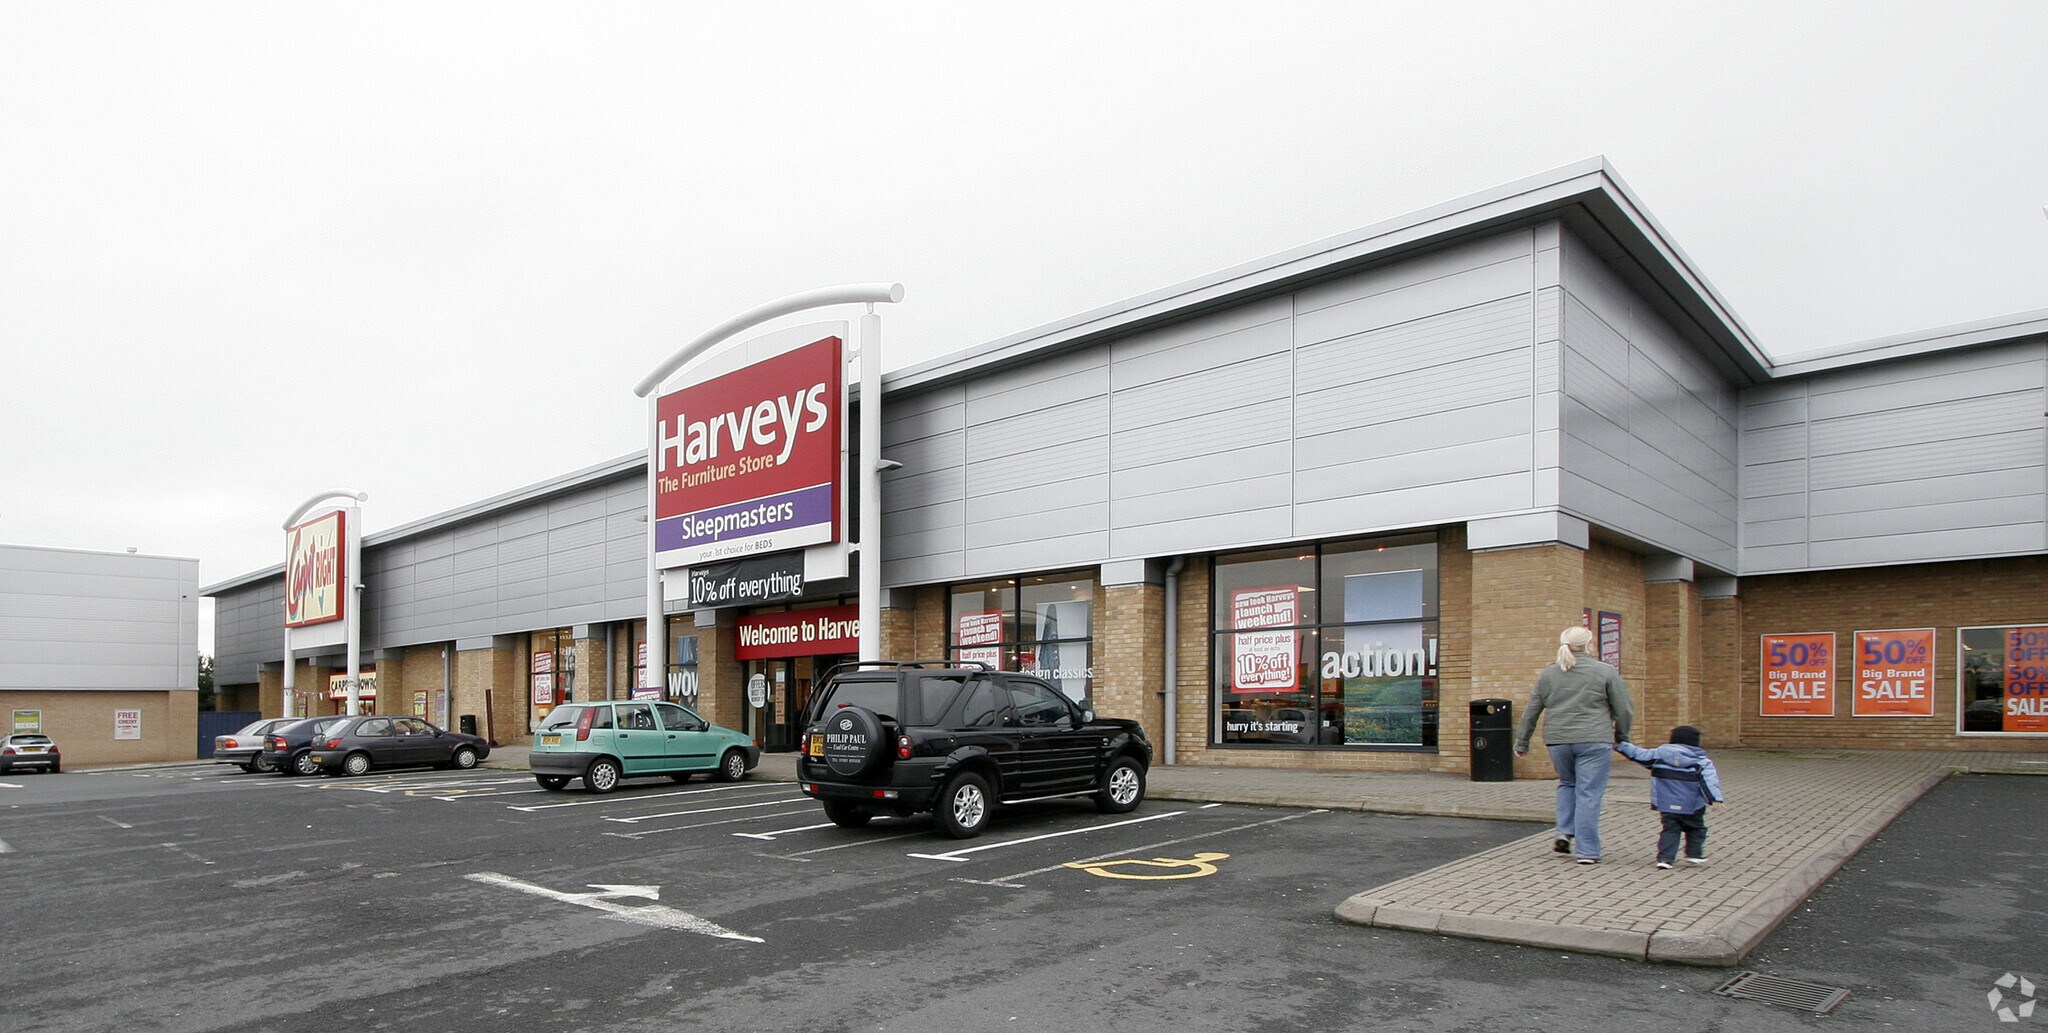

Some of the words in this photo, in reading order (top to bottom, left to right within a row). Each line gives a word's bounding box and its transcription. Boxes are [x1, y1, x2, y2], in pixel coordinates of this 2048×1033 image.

[658, 382, 829, 472] Harveys
[658, 478, 678, 494] The
[682, 464, 735, 489] Furniture
[739, 454, 774, 475] Store
[682, 501, 794, 541] Sleepmasters
[699, 551, 712, 561] your
[723, 545, 743, 555] choice
[744, 542, 754, 552] for
[755, 539, 773, 550] BEDS
[316, 545, 335, 588] RIGHT
[691, 577, 717, 604] 10%
[720, 578, 736, 600] off
[739, 570, 801, 599] everything
[1250, 597, 1265, 606] look
[1266, 592, 1294, 602] Harveys
[1237, 610, 1291, 629] weekend!
[1240, 604, 1273, 617] launch
[740, 624, 798, 647] Welcome
[801, 620, 815, 641] to
[818, 617, 860, 640] Harve
[962, 630, 997, 646] weekend!
[1238, 635, 1252, 645] half
[1254, 635, 1273, 646] price
[1275, 633, 1291, 645] plus
[1321, 638, 1437, 679] action!
[1770, 642, 1827, 667] 50%
[1864, 639, 1926, 665] 50%
[1906, 656, 1926, 664] OFF
[1238, 654, 1268, 674] 10%
[1270, 653, 1288, 669] off
[1053, 667, 1093, 680] classics
[1240, 667, 1290, 683] everything!
[1769, 671, 1787, 680] Big
[1791, 670, 1826, 679] Brand
[1862, 669, 1882, 679] Big
[1887, 668, 1925, 677] Brand
[1768, 681, 1826, 699] SALE
[1862, 680, 1925, 699] SALE
[117, 711, 138, 719] FREE
[2007, 698, 2048, 716] SALE
[1226, 721, 1249, 733] hurry
[1250, 720, 1262, 731] it's
[1265, 720, 1299, 733] starting
[826, 734, 849, 743] PHILIP
[850, 734, 867, 744] PAUL
